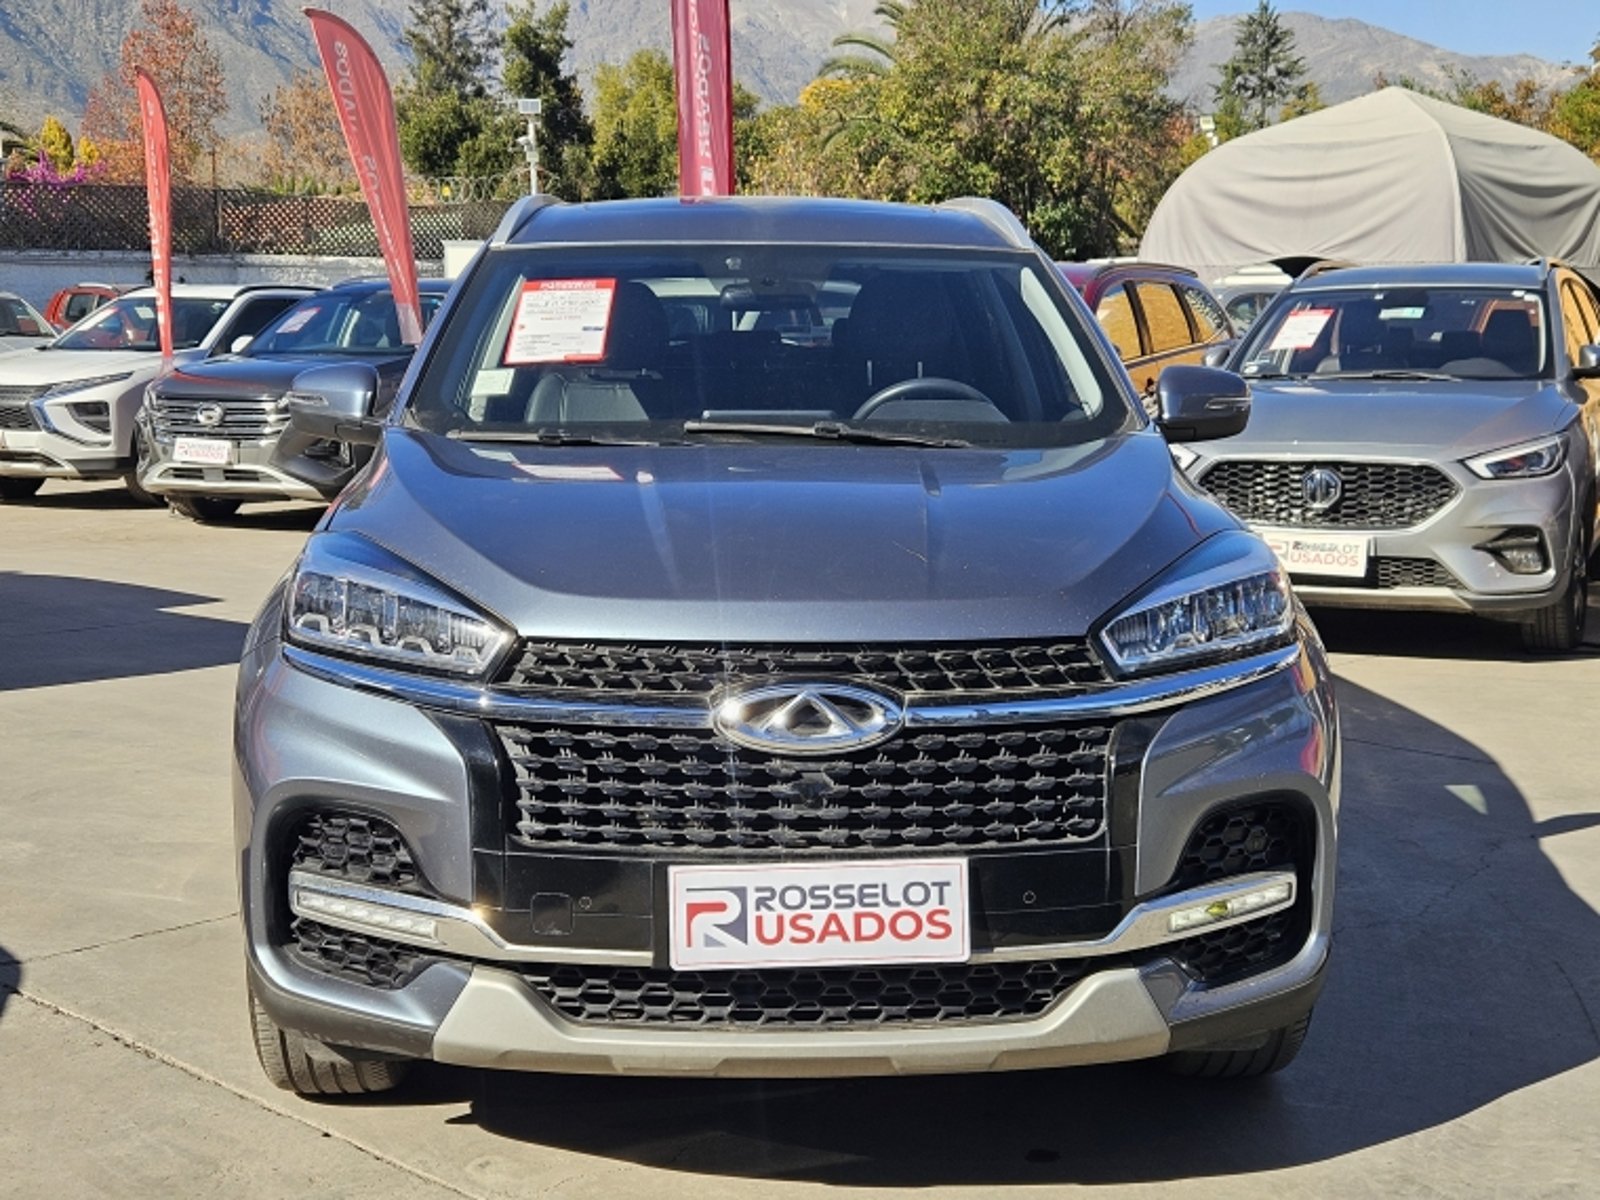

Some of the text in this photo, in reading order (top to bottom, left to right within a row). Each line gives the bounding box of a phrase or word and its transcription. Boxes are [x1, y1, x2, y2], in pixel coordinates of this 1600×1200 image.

[1290, 551, 1359, 567] USADOS
[754, 881, 952, 912] ROSSELOT
[755, 909, 953, 946] USADOS
